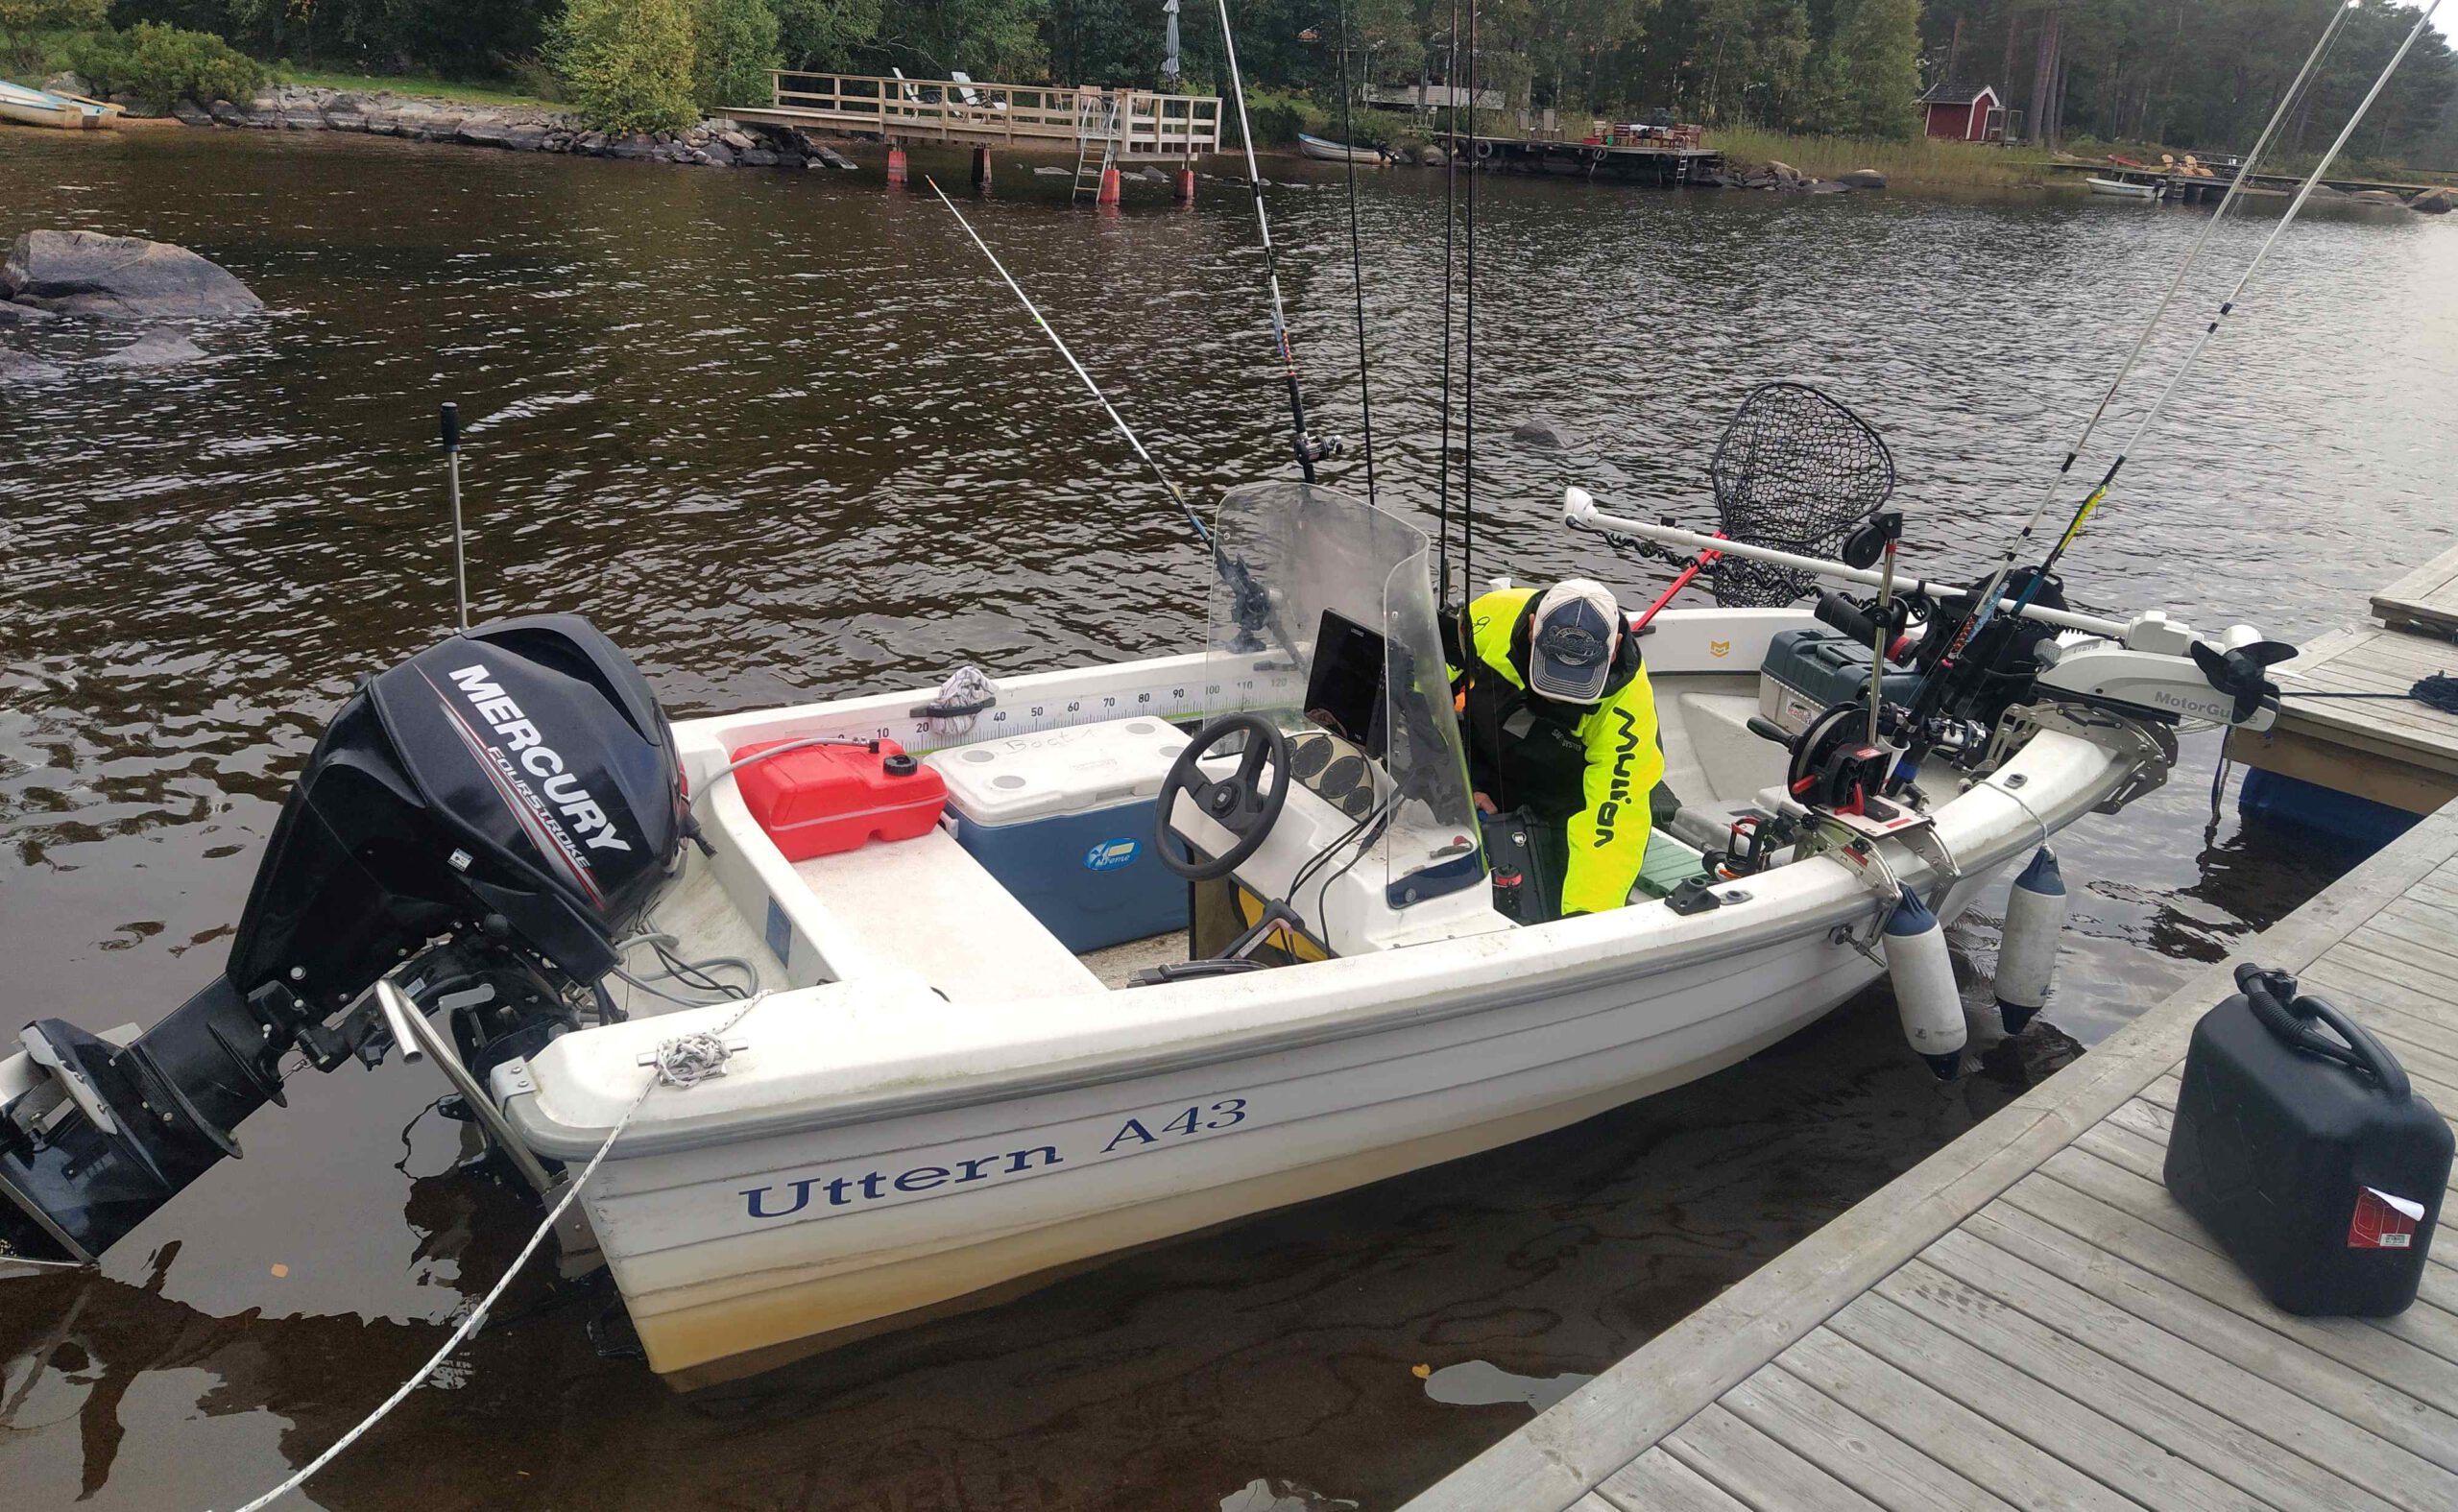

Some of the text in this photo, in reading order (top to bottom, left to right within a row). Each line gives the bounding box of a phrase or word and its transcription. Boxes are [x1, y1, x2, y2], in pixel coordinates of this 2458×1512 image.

[447, 663, 632, 852] MERCURY
[877, 728, 889, 738] 10
[916, 722, 929, 733] 20
[993, 711, 1006, 722] 40
[1030, 707, 1044, 717] 50
[1067, 702, 1080, 712] 60
[1103, 697, 1116, 708] 70
[1138, 693, 1150, 703] 80
[1172, 688, 1185, 698] 90
[1205, 684, 1220, 695] 100
[1270, 678, 1288, 687] 120
[1005, 731, 1073, 754] Boat
[2154, 690, 2258, 724] MotorGue
[484, 746, 590, 869] FOURSTROKE
[1593, 707, 1639, 849] Mullion
[737, 1097, 1247, 1219] Uttern A43
